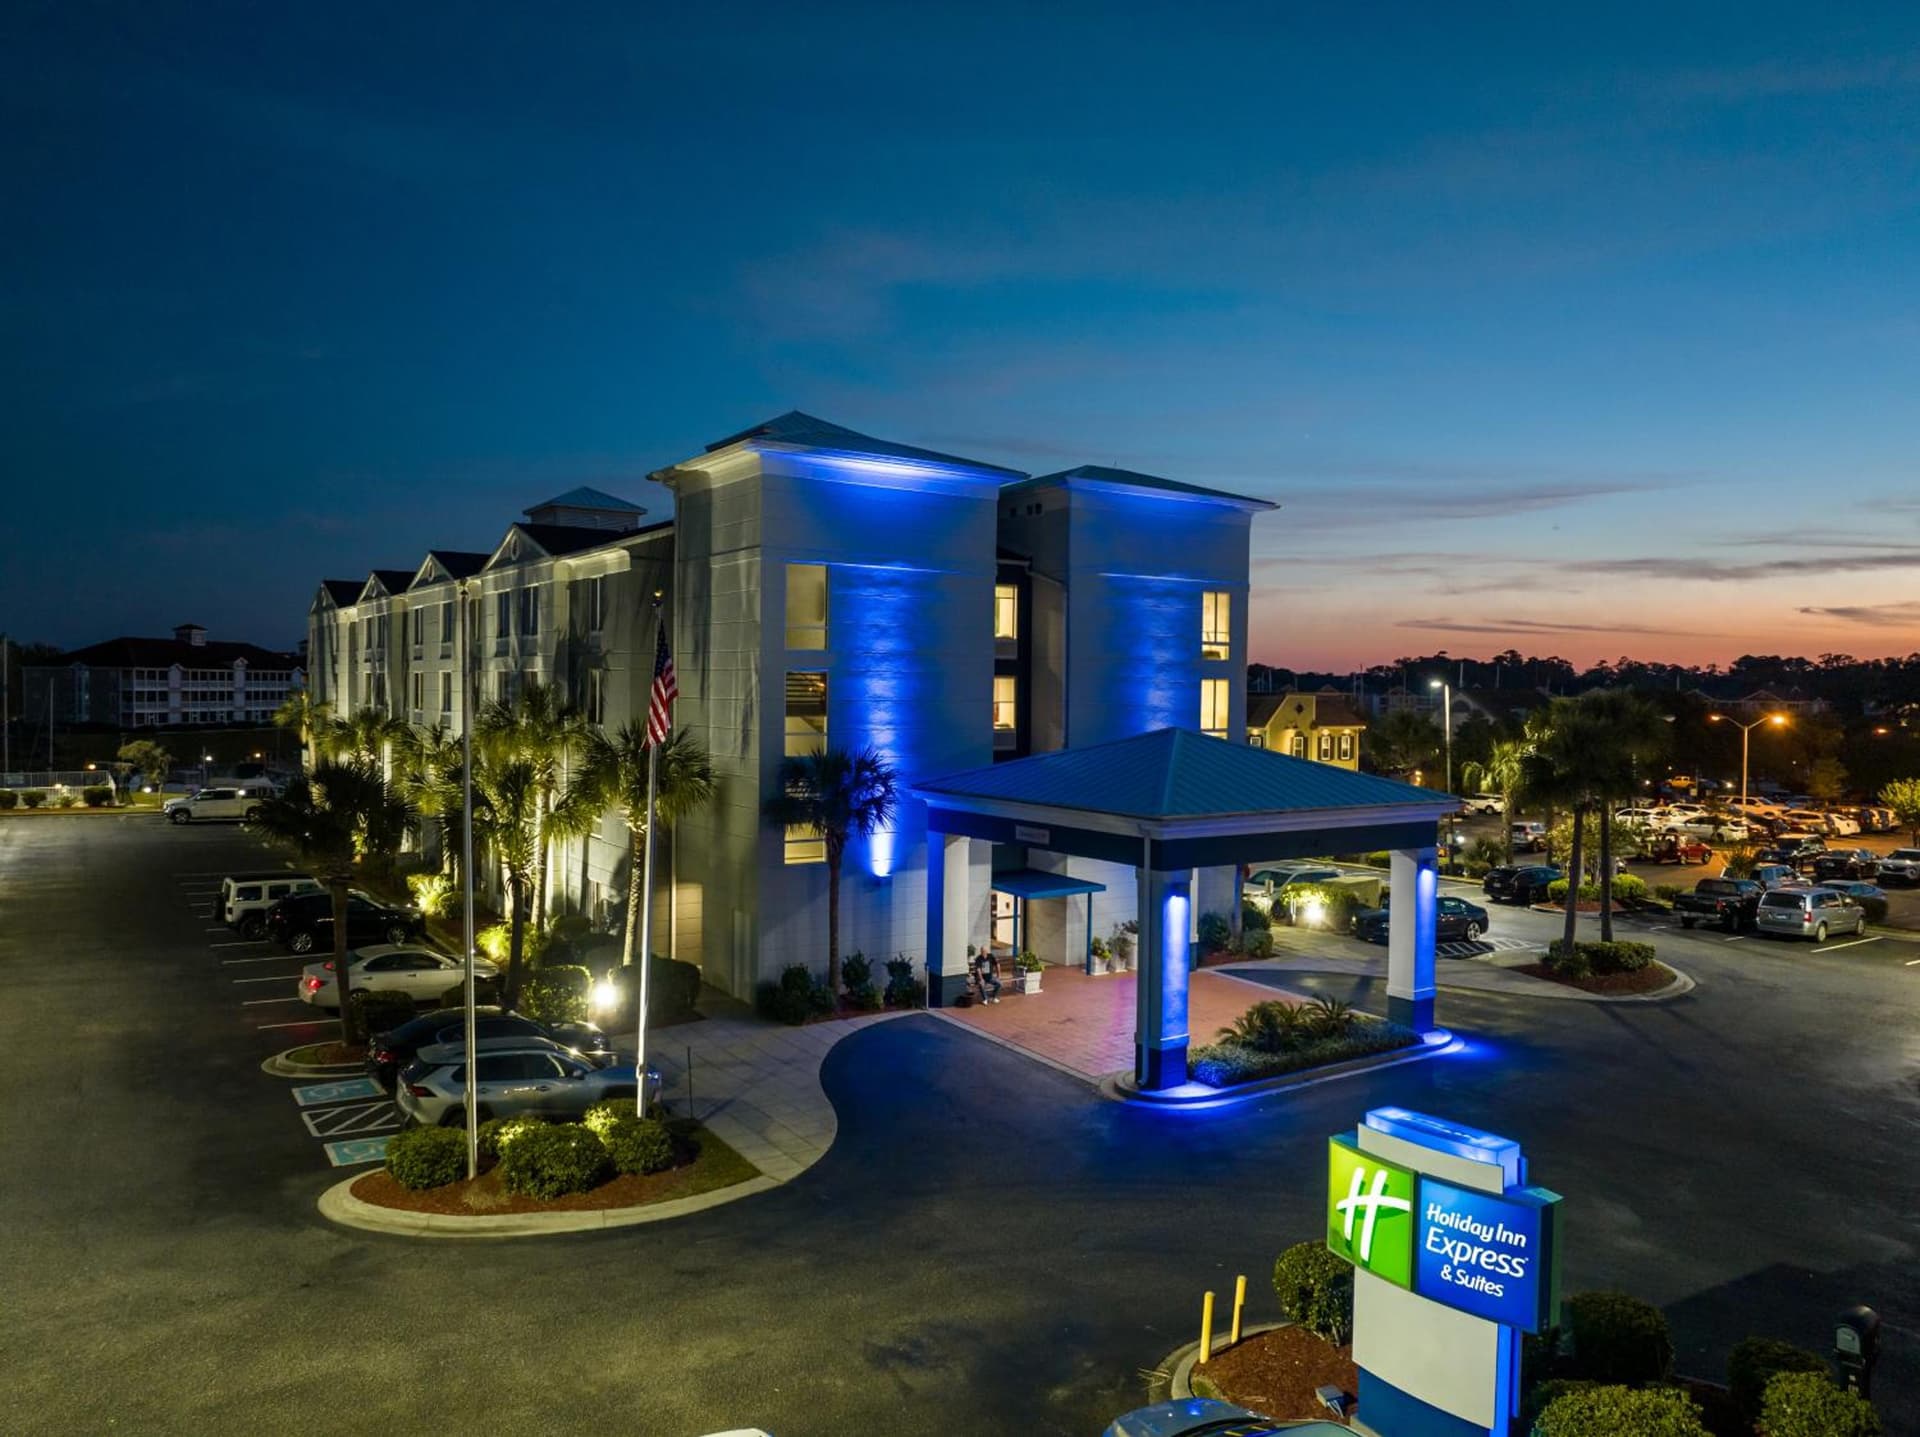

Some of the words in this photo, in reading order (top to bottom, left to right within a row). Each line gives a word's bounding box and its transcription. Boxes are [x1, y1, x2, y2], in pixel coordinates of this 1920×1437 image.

[1426, 1203, 1494, 1244] Holiday
[1495, 1223, 1527, 1248] Inn
[1425, 1227, 1526, 1278] Express
[1440, 1265, 1453, 1282] &
[1455, 1269, 1504, 1297] Suites
